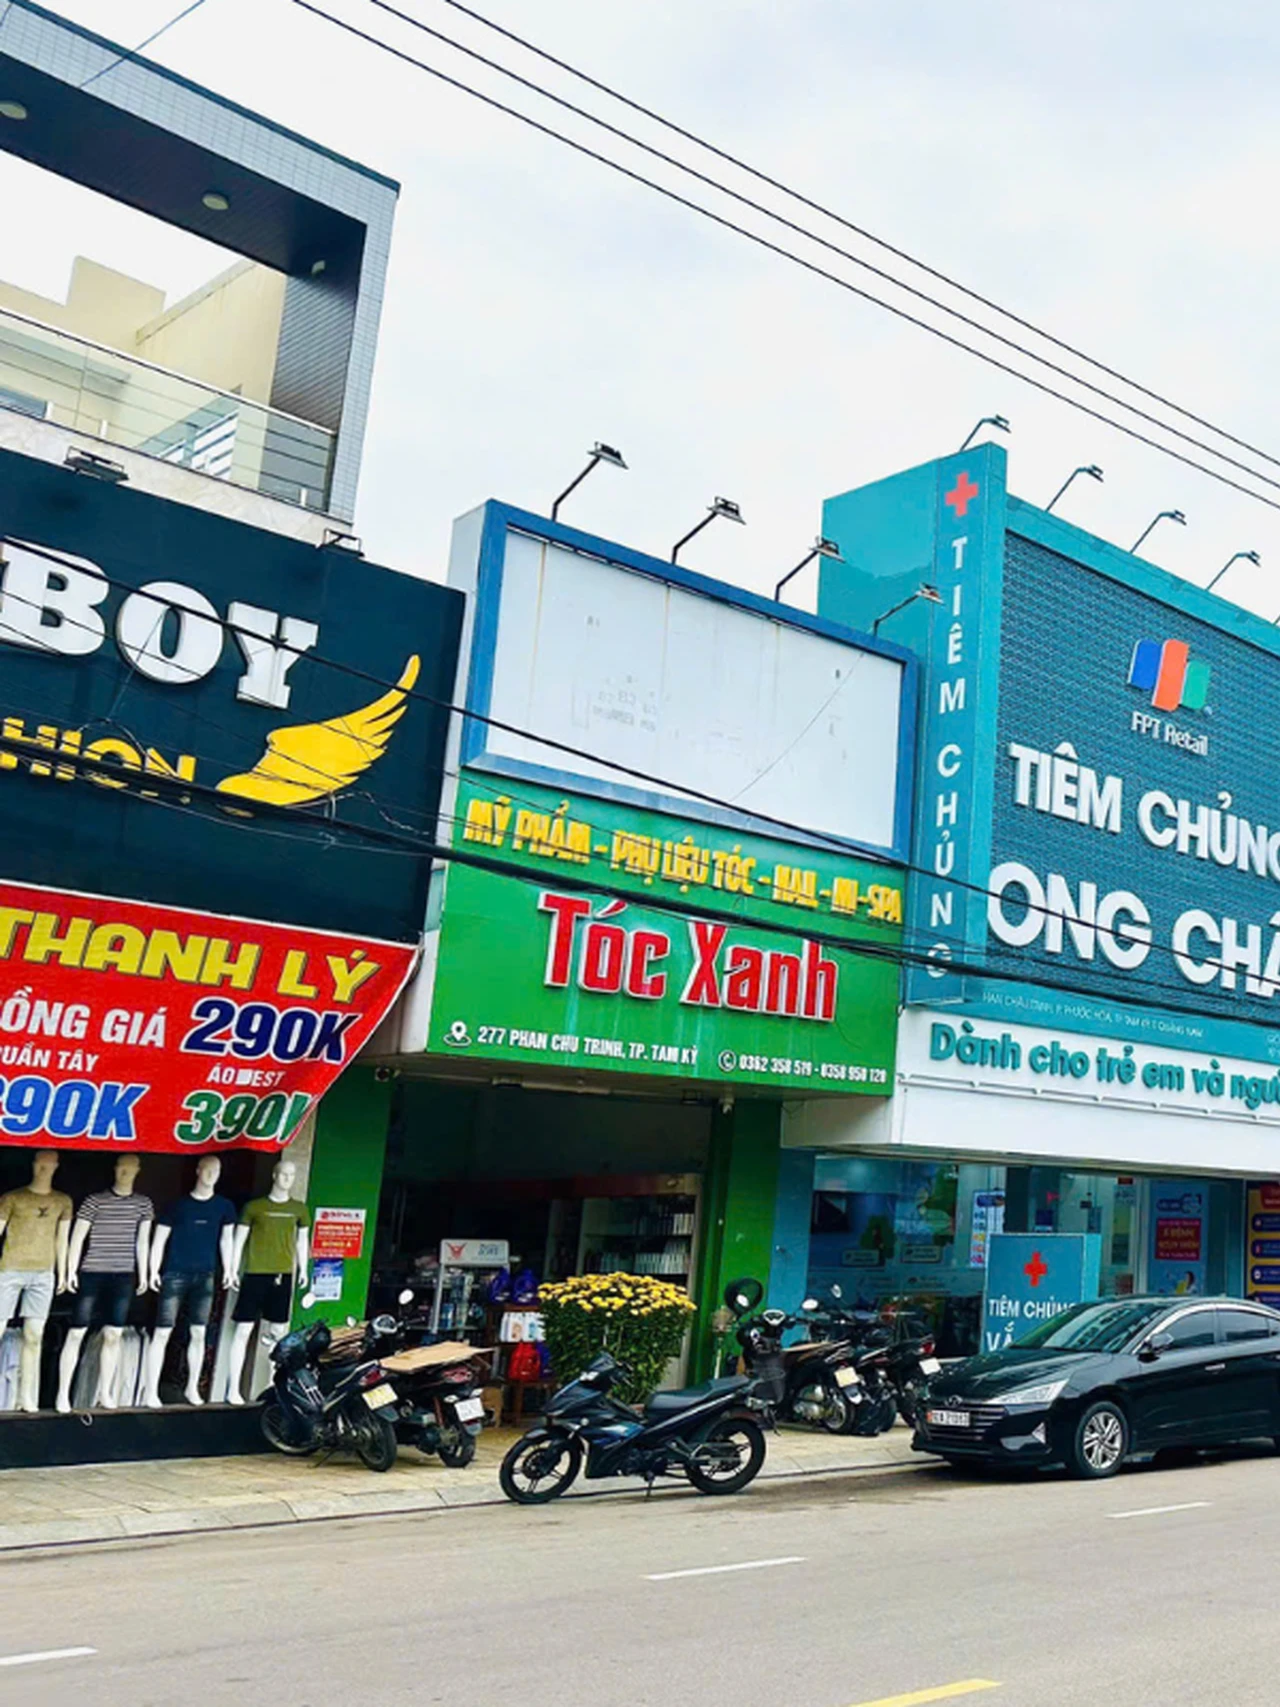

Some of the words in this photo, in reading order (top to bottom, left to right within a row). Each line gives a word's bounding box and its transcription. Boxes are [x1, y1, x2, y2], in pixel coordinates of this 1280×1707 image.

[0, 535, 318, 709] BOY
[1130, 711, 1161, 739] FPT
[1163, 724, 1208, 756] Retail
[1007, 741, 1123, 834] TIÊM
[713, 845, 756, 895] TÓC
[986, 861, 1153, 969] ONG
[0, 906, 260, 990] THANH
[277, 949, 382, 1003] LÝ
[538, 891, 670, 1000] Tóc
[680, 917, 838, 1024] Xanh
[0, 1041, 51, 1068] UẦN
[57, 1049, 99, 1073] TÂY
[101, 1006, 168, 1049] GIÁ
[180, 996, 365, 1064] 290K
[477, 1025, 505, 1044] 277
[509, 1029, 548, 1051] PHAN
[551, 1034, 578, 1053] CHU
[629, 1042, 649, 1060] TP.
[652, 1044, 679, 1064] TAM
[929, 1020, 1021, 1071] Dành
[1029, 1040, 1090, 1078] cho
[1096, 1045, 1136, 1085] trẻ
[1141, 1061, 1185, 1092] em
[1191, 1058, 1225, 1097] và
[0, 1074, 150, 1141] 90K
[207, 1064, 236, 1085] ÁO
[235, 1068, 286, 1087] EST
[988, 1294, 1019, 1317] TIÊM
